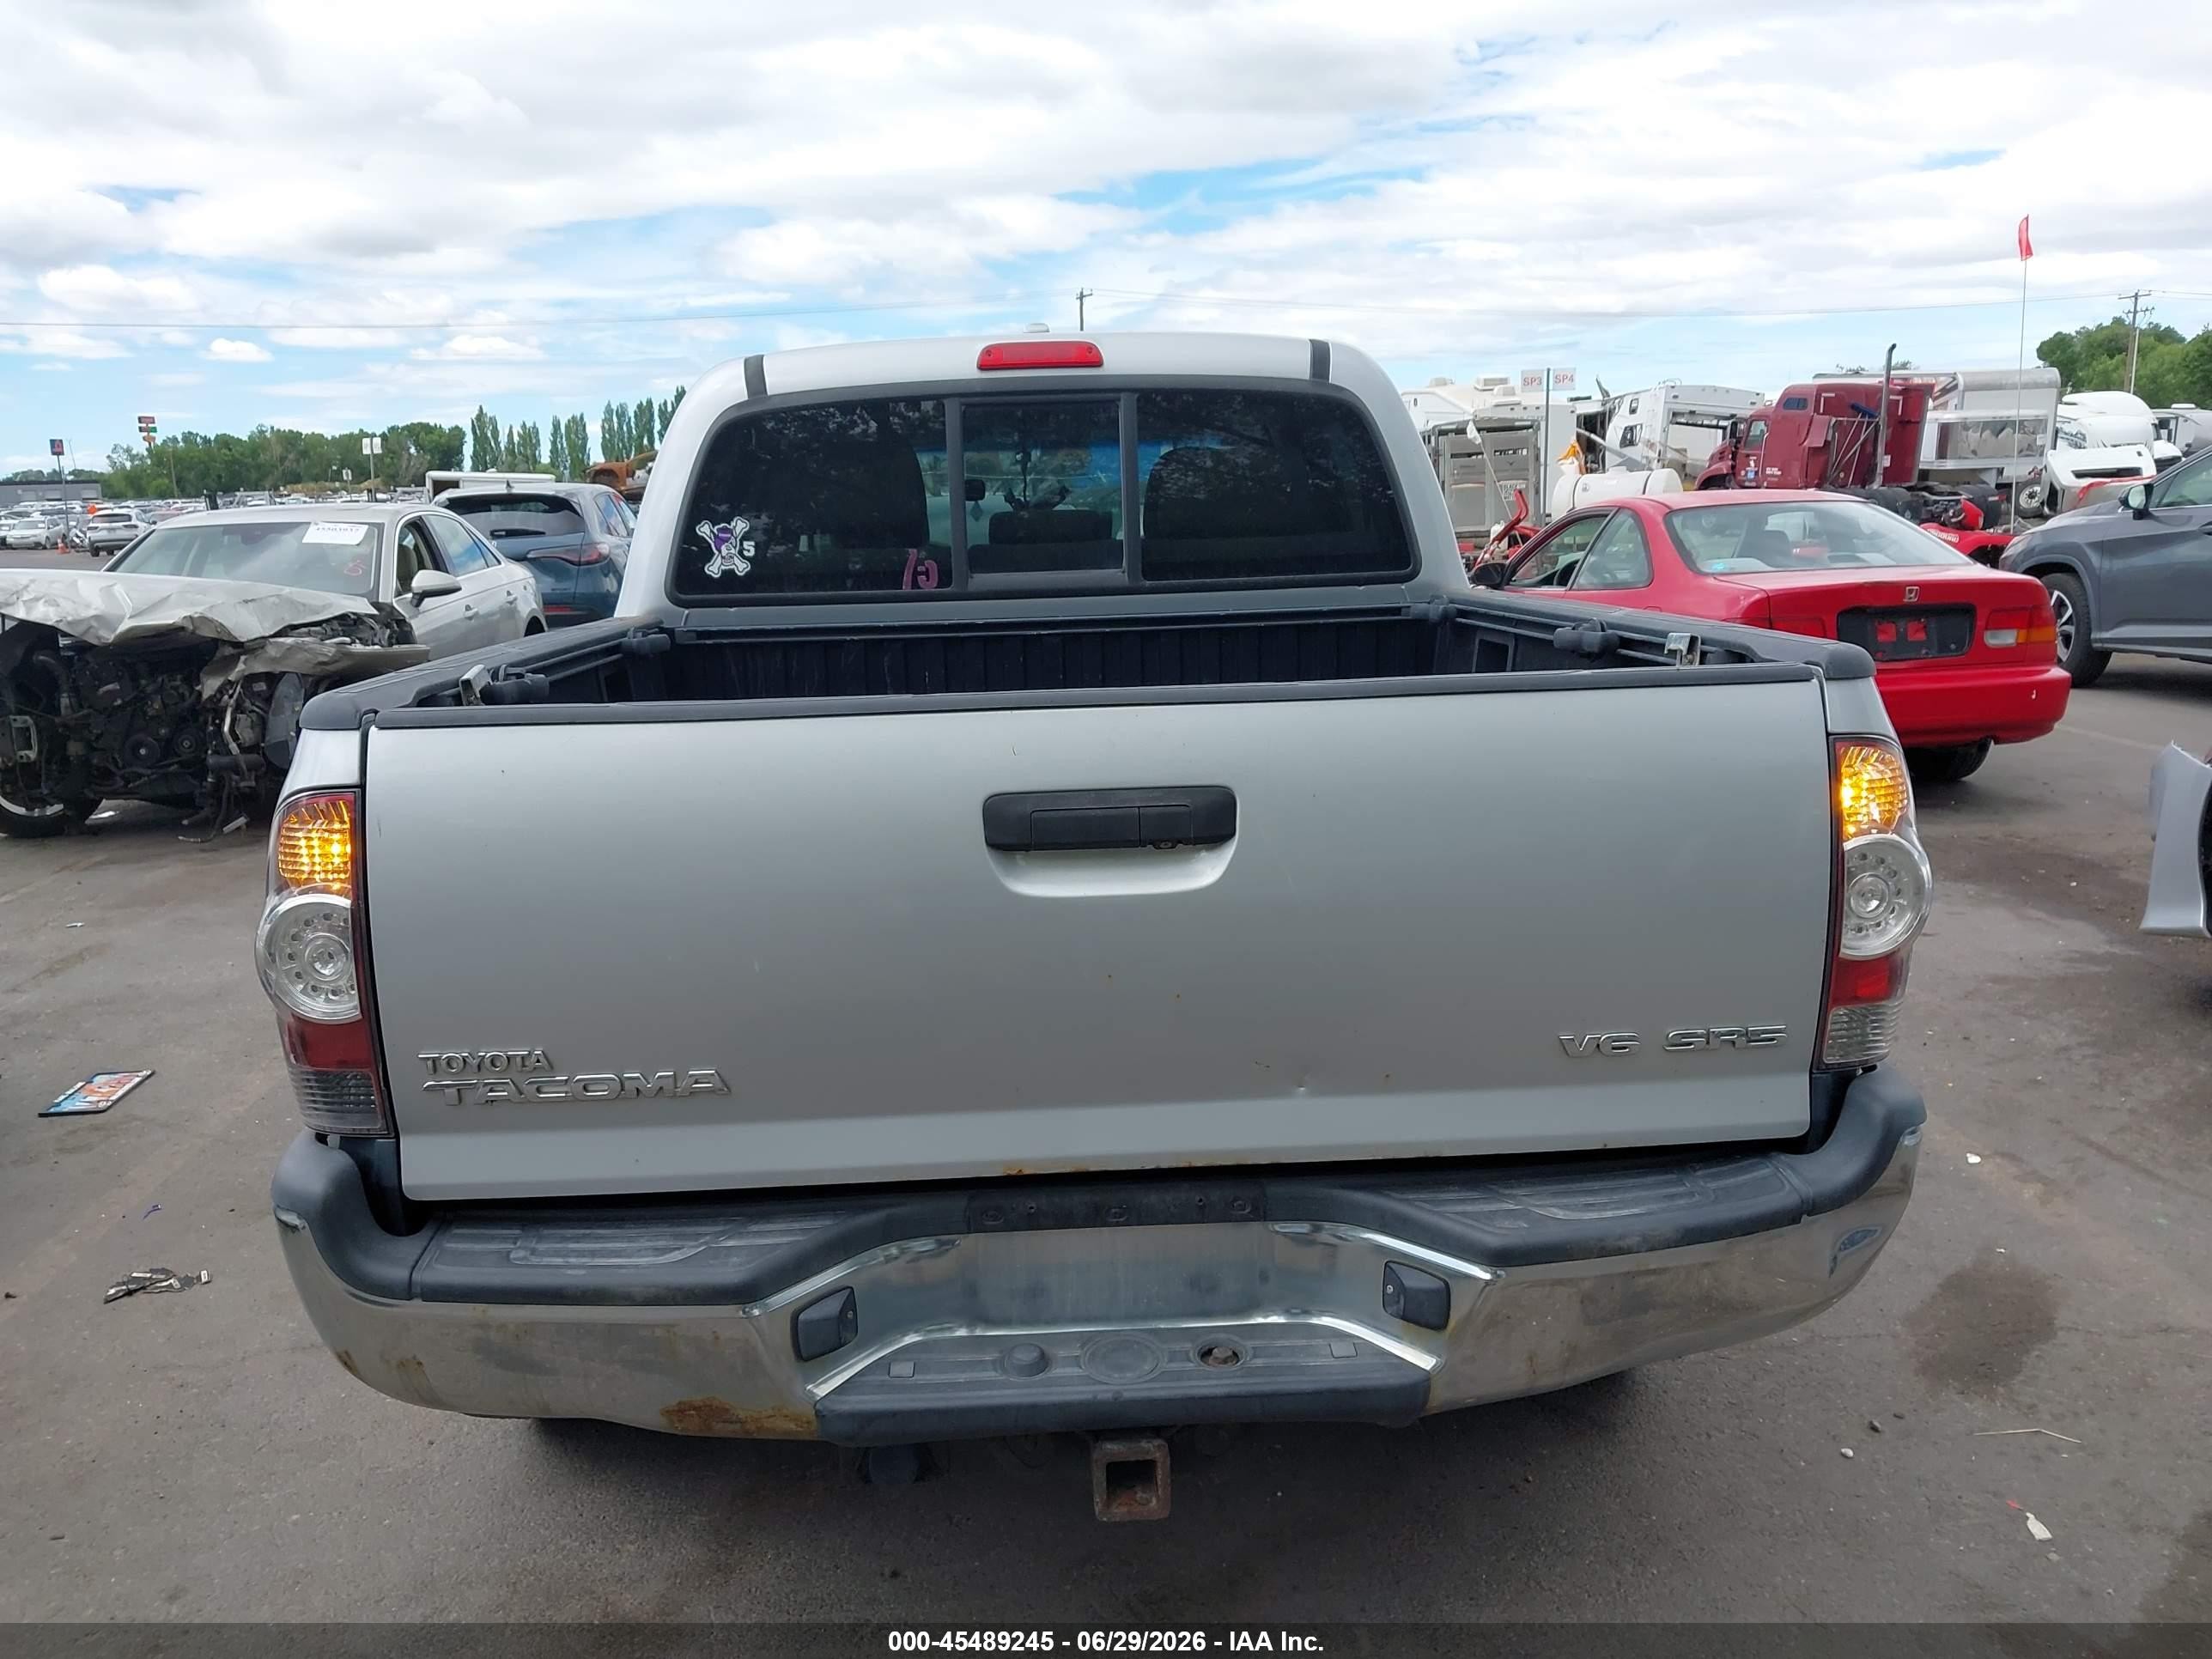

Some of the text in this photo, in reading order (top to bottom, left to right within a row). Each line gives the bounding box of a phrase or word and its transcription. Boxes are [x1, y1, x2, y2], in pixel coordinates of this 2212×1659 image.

[1523, 377, 1542, 386] SP3
[1555, 374, 1574, 384] SP4
[743, 541, 755, 556] 5
[1559, 1024, 1788, 1057] V6 SR5
[417, 1049, 552, 1074] TOYOTA
[422, 1070, 731, 1106] TACOMA
